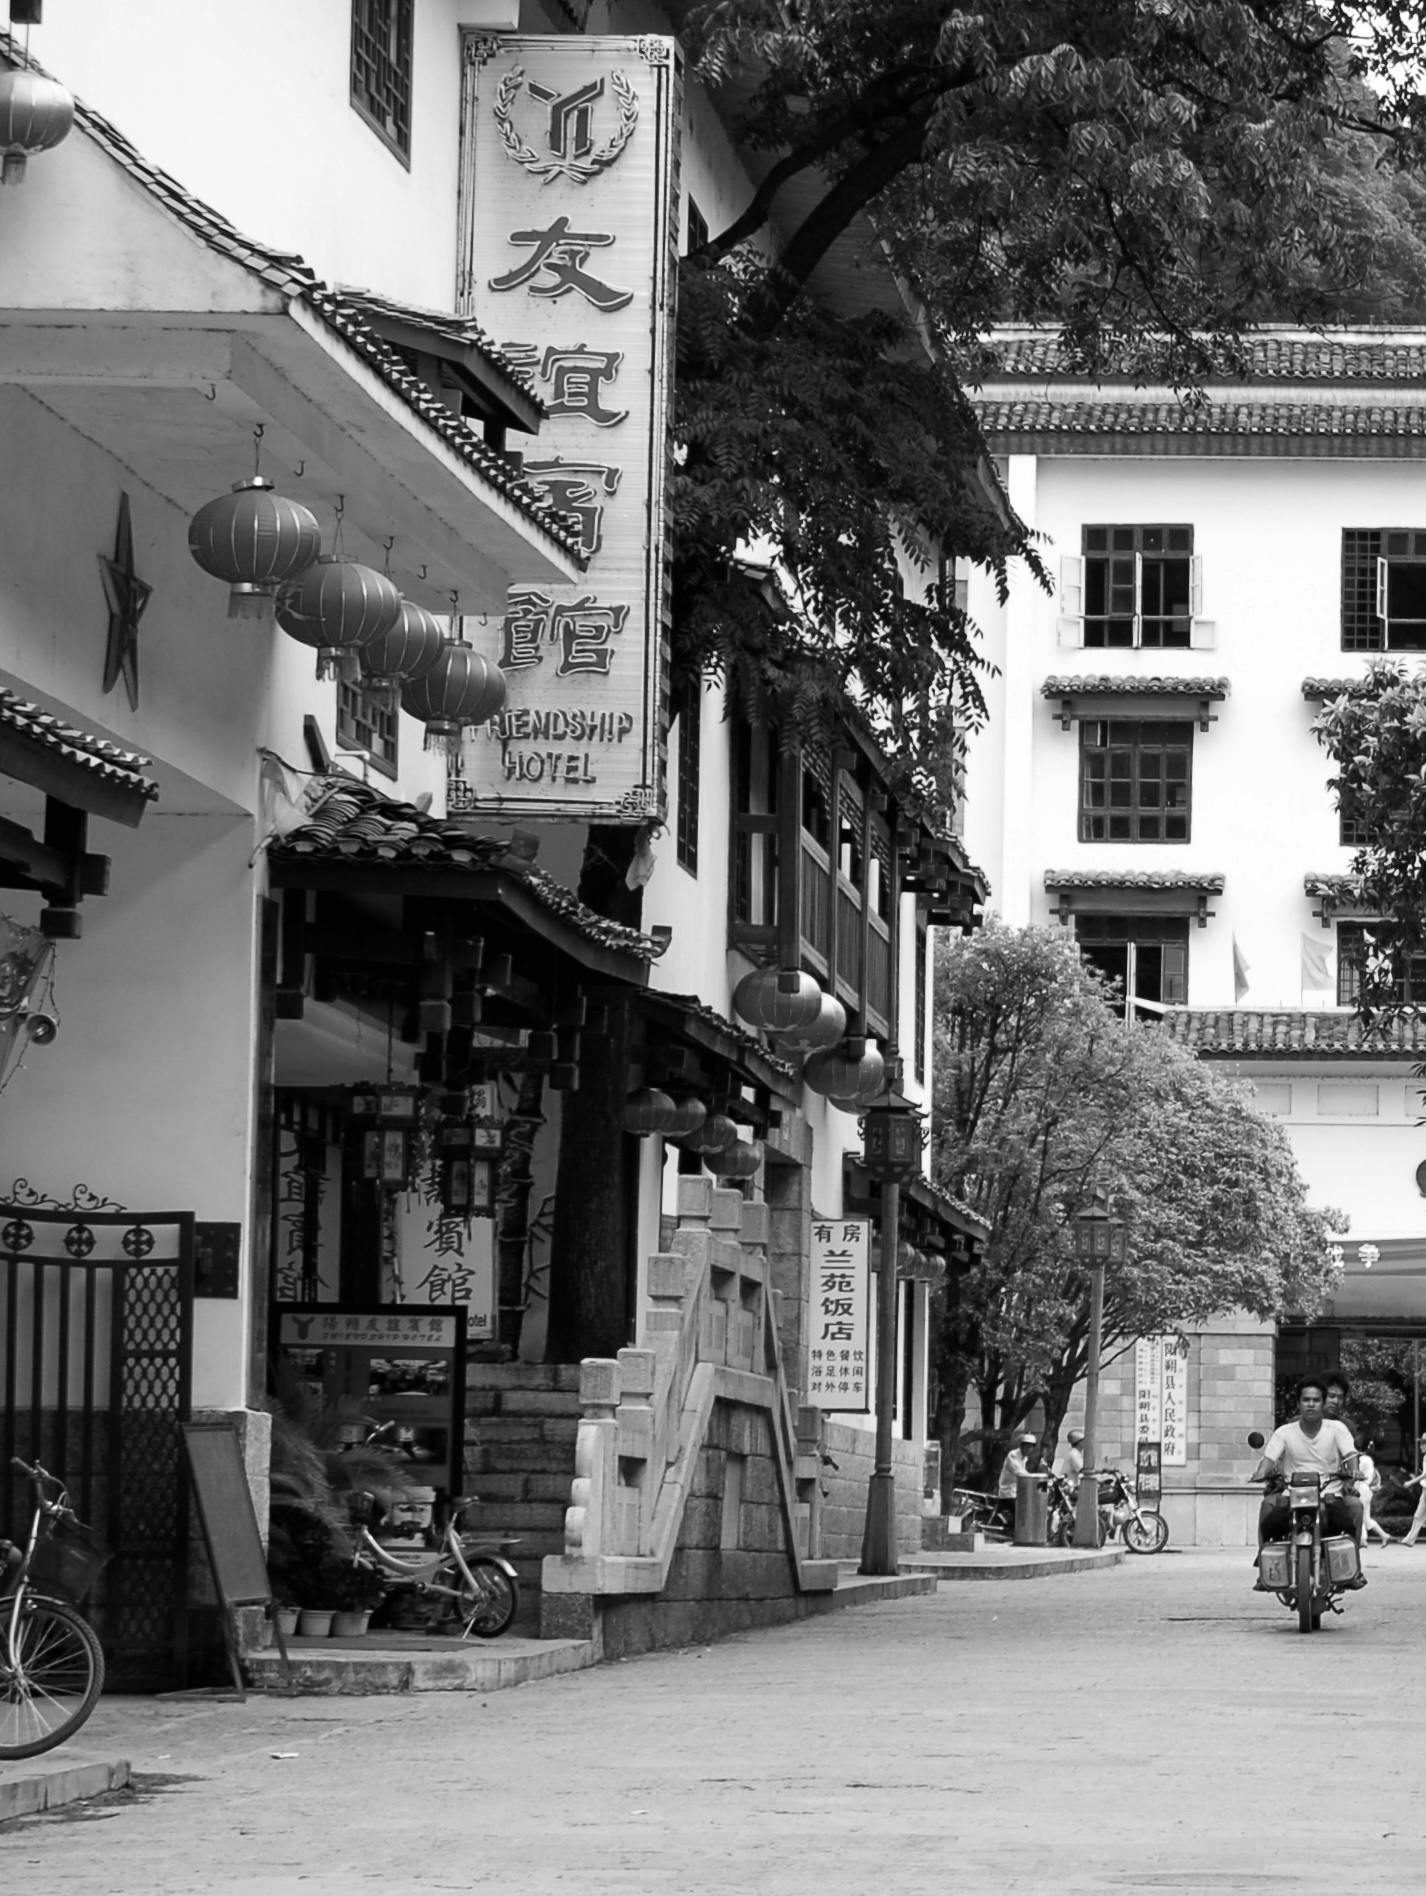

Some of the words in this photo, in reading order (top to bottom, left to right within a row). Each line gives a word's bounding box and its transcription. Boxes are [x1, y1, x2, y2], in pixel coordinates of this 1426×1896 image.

[502, 751, 597, 784] HOTEL
[813, 1224, 862, 1244] 有房
[820, 1249, 856, 1341] 兰苑饭店
[467, 1313, 489, 1329] otel
[811, 1380, 864, 1393] 对外停车
[1163, 1342, 1177, 1457] 阳朔县人民政府
